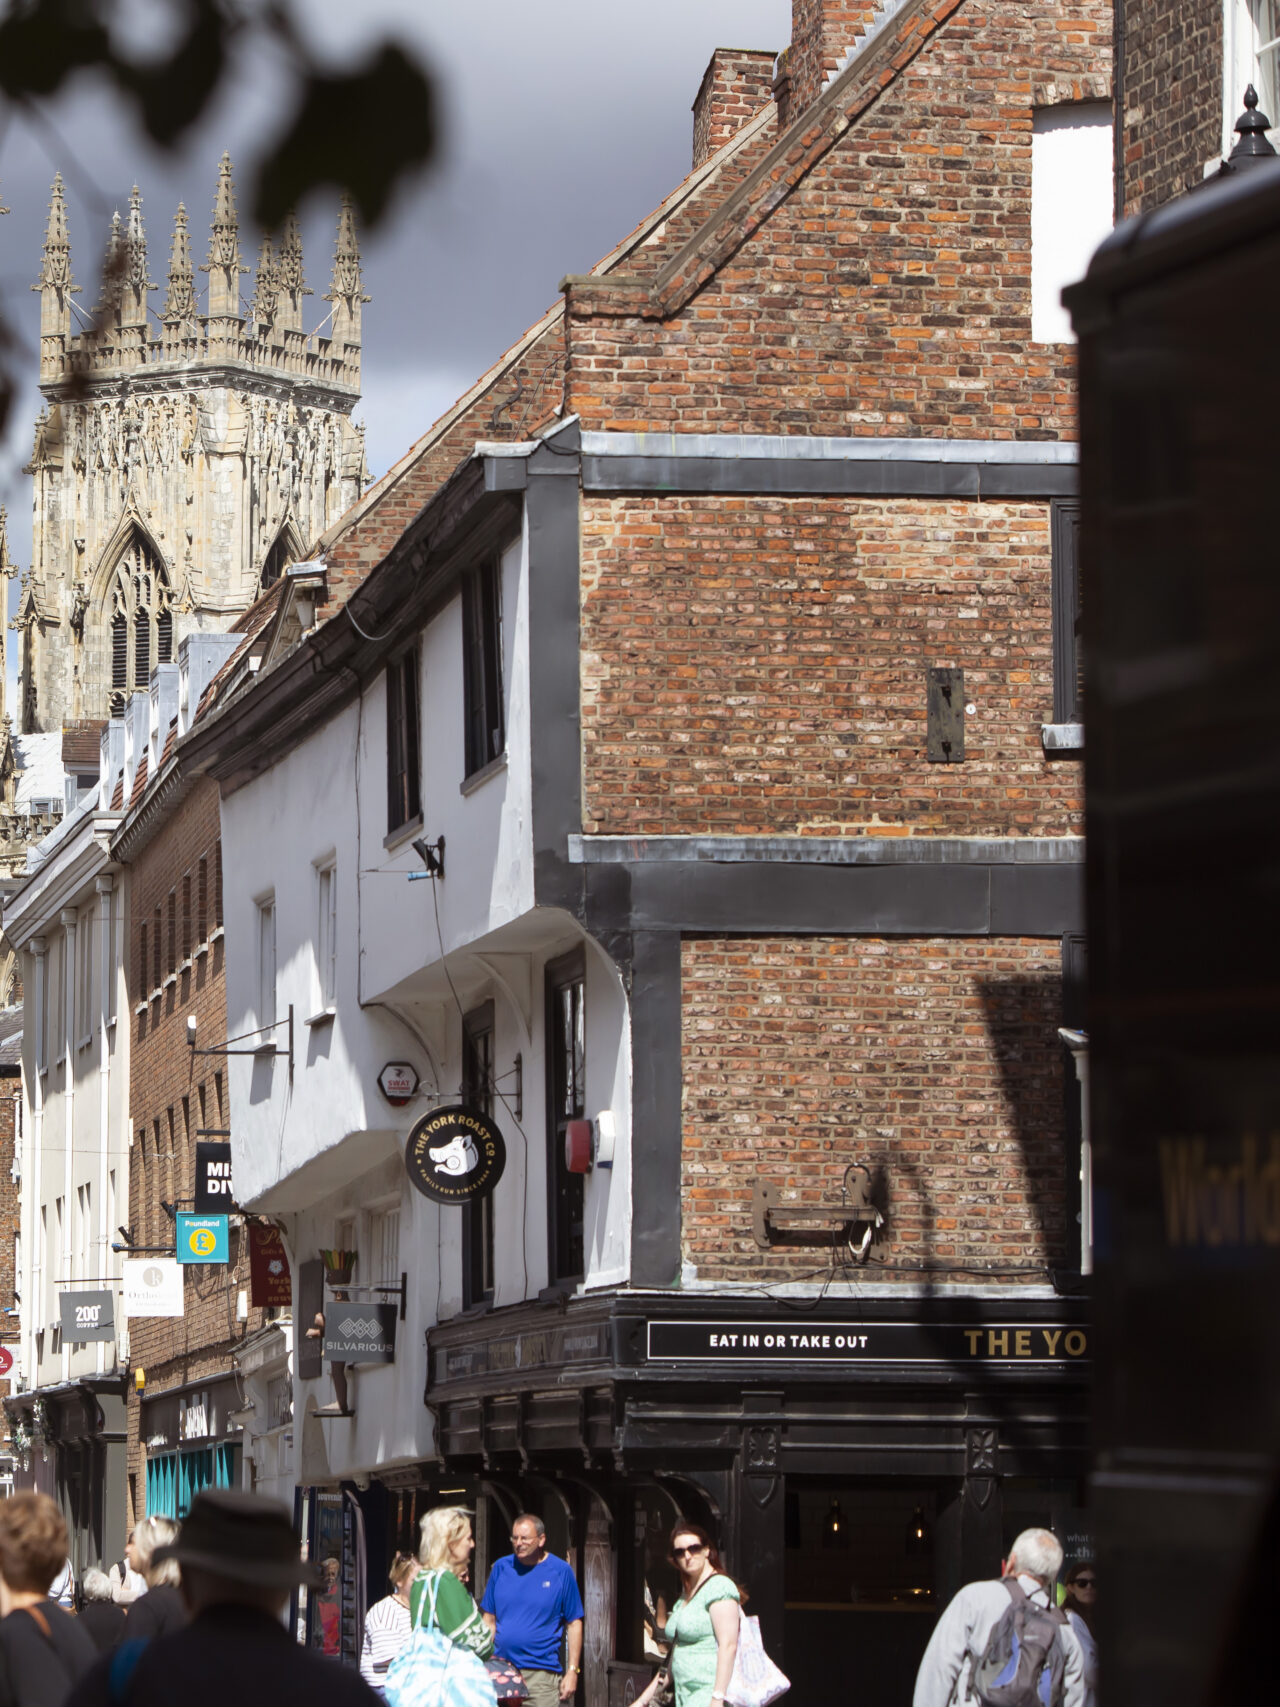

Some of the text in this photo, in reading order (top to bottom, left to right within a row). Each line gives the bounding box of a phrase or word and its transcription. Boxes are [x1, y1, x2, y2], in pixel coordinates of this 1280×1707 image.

[415, 1132, 430, 1156] THE
[425, 1114, 456, 1134] YORK
[458, 1115, 491, 1140] ROAST
[207, 1162, 232, 1177] MI
[420, 1169, 439, 1189] FAMILY
[439, 1187, 455, 1195] RUN
[456, 1184, 478, 1195] SINCE
[326, 1341, 394, 1353] SILVARIOUS
[709, 1334, 869, 1349] EAT IN OR TAKE OUT
[963, 1330, 1033, 1356] THE
